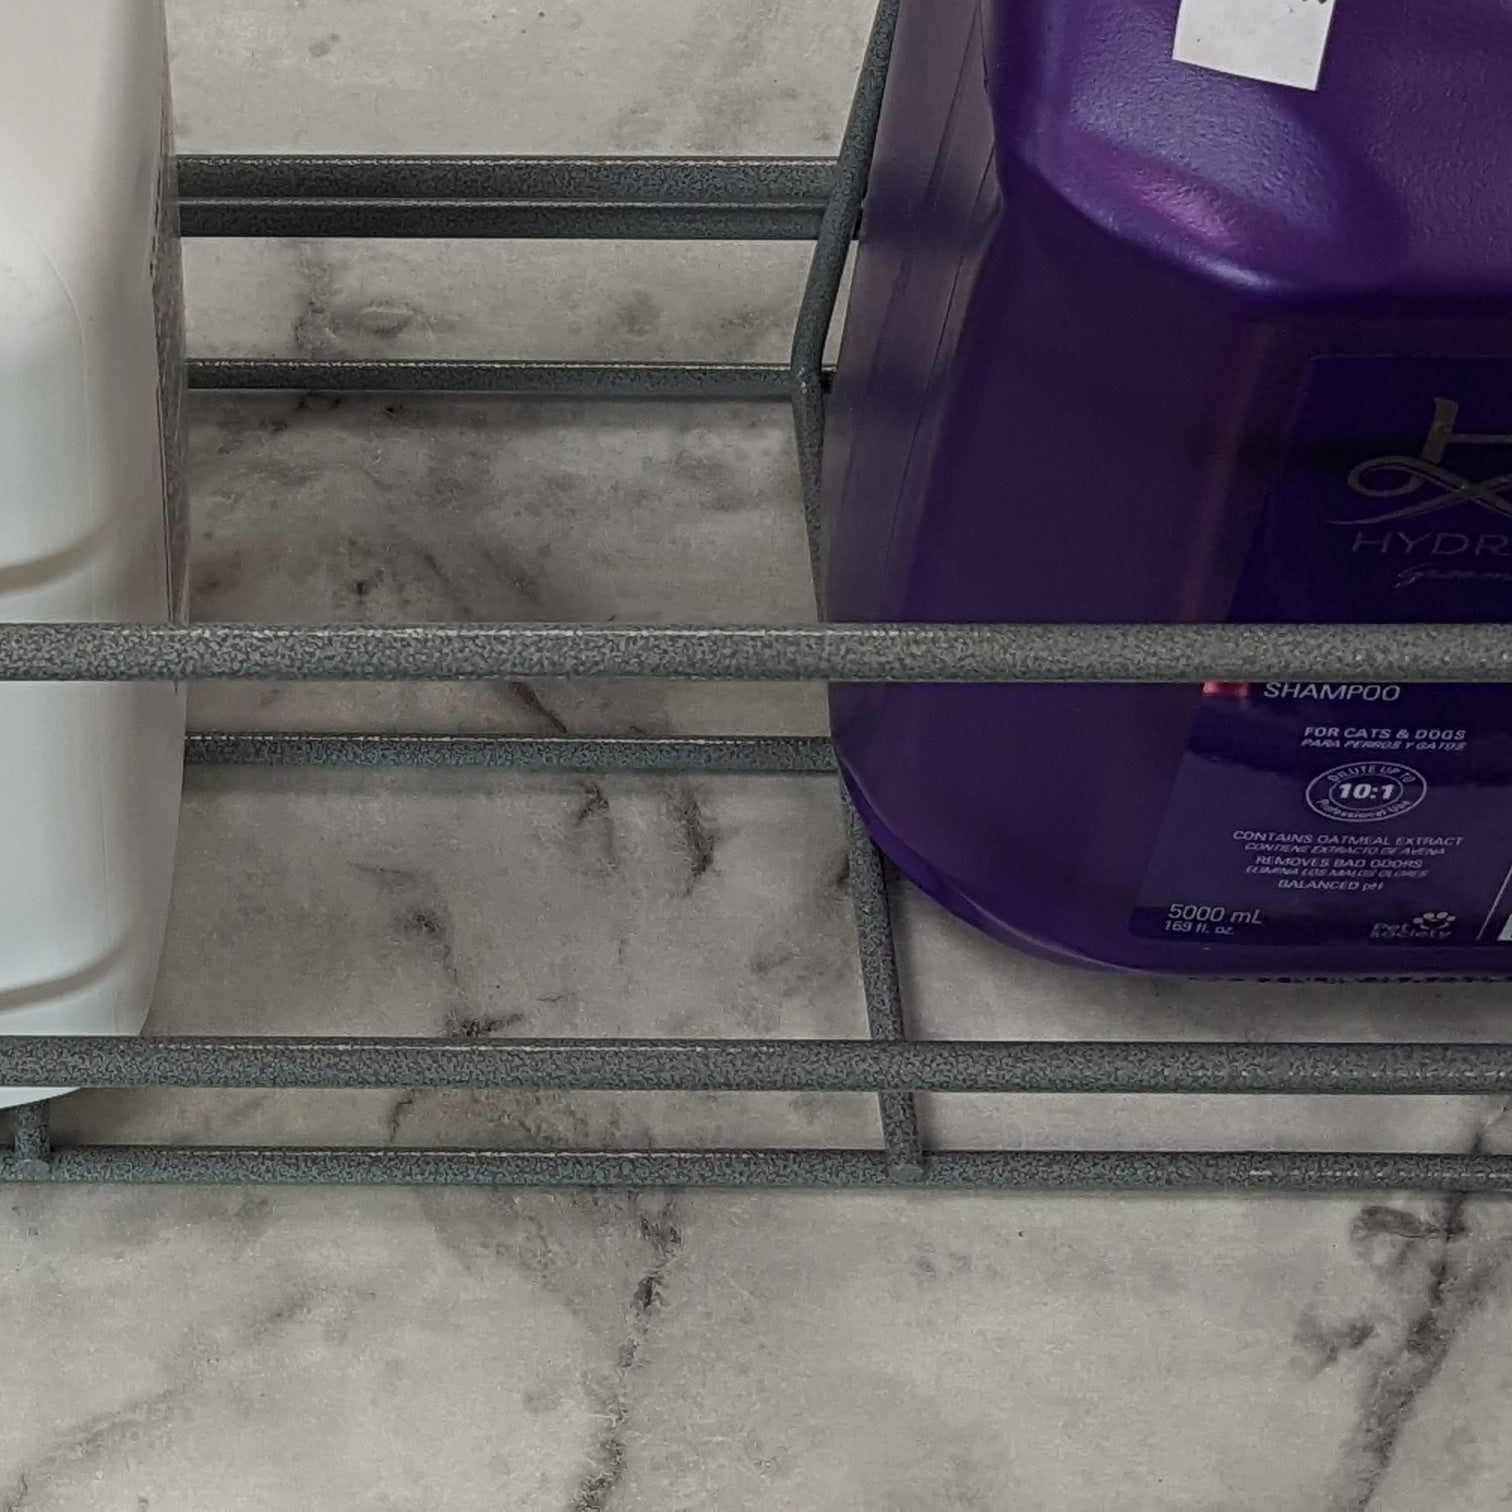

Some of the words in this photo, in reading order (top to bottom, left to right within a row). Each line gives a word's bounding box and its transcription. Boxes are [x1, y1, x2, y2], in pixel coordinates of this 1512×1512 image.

[1263, 682, 1401, 701] SHAMPOO
[1304, 726, 1339, 738] FOR
[1344, 727, 1391, 739] CATS
[1396, 729, 1410, 739] &
[1415, 729, 1467, 740] DOGS
[1338, 782, 1395, 799] 10:1
[1233, 830, 1313, 843] CONTAINS
[1395, 836, 1464, 846] EXTRACT
[1334, 858, 1366, 868] BAD
[1278, 879, 1360, 891] BALANCED
[1168, 903, 1226, 922] 5000
[1230, 908, 1264, 925] mL
